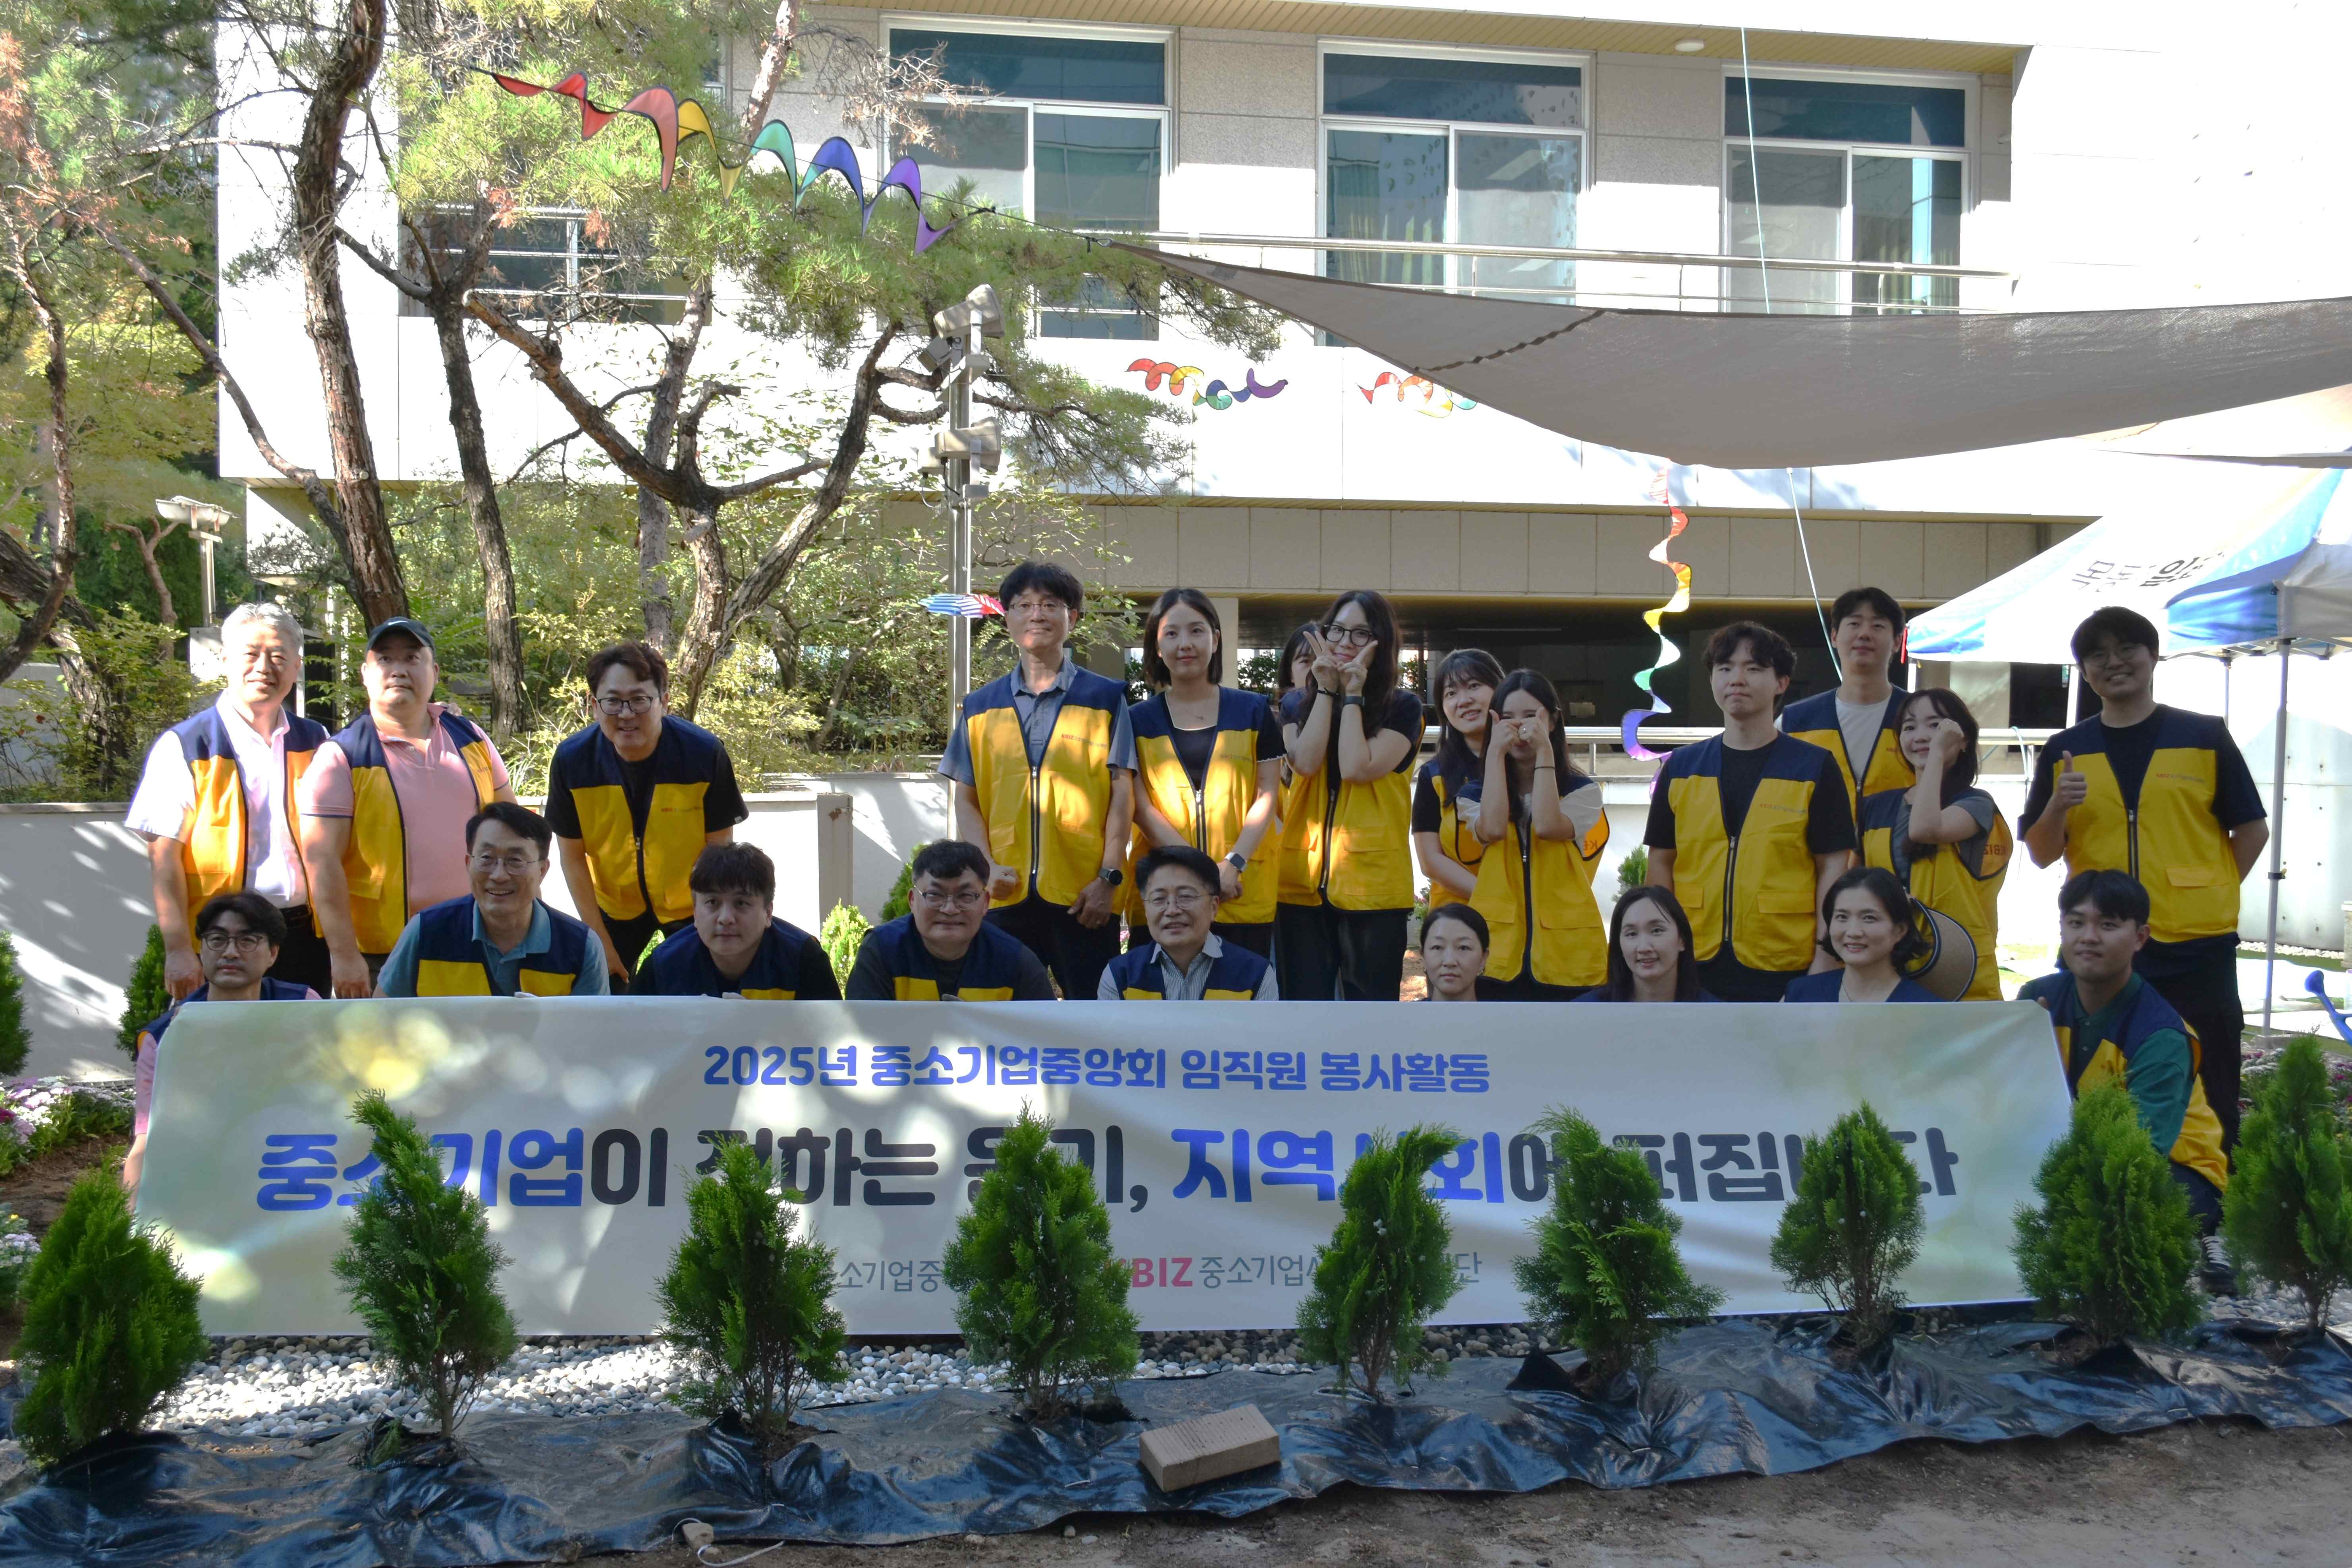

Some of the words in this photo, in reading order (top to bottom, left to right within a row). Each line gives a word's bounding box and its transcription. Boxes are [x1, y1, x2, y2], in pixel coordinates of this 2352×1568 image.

[704, 1045, 857, 1086] 2025년
[871, 1045, 1166, 1089] 중소기업중앙회
[1181, 1049, 1307, 1091] 임직원
[1320, 1052, 1490, 1093] 봉사활동
[1171, 1128, 1572, 1203] 지역회에
[1105, 1257, 1193, 1287] BIZ
